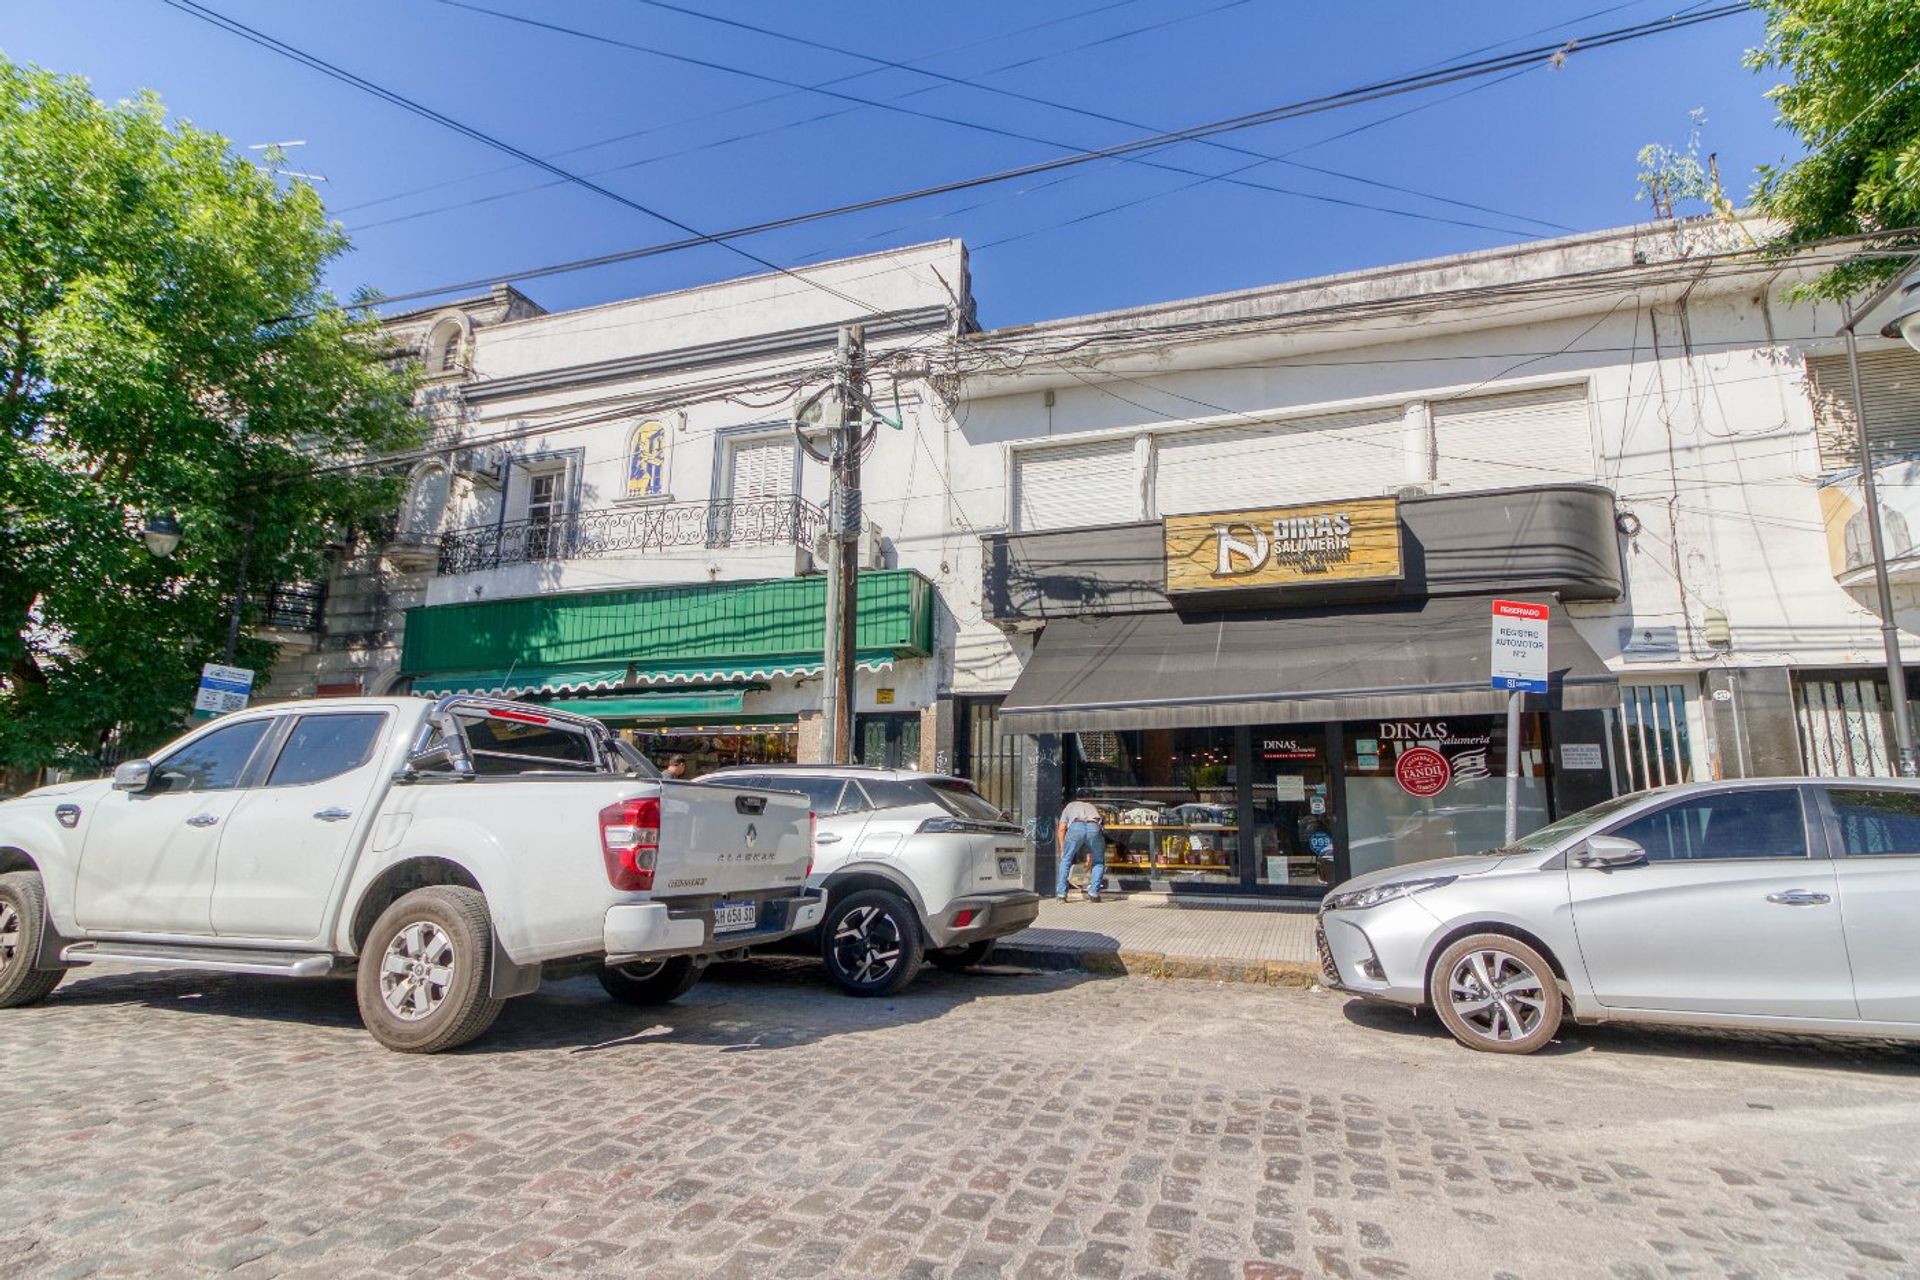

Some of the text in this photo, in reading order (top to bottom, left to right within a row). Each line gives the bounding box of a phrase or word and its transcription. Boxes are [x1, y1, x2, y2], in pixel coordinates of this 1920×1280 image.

[1272, 512, 1351, 540] DINAS
[1274, 536, 1350, 554] SALUMERIA
[1500, 606, 1540, 617] RESERVADO
[1500, 627, 1539, 639] REGISTRO
[1495, 638, 1544, 650] AUTOMOTOR
[1380, 722, 1448, 739] DINAS
[1263, 740, 1296, 750] DINAS
[1439, 734, 1490, 745] Salumeria
[726, 907, 742, 923] 658
[743, 906, 754, 922] SD
